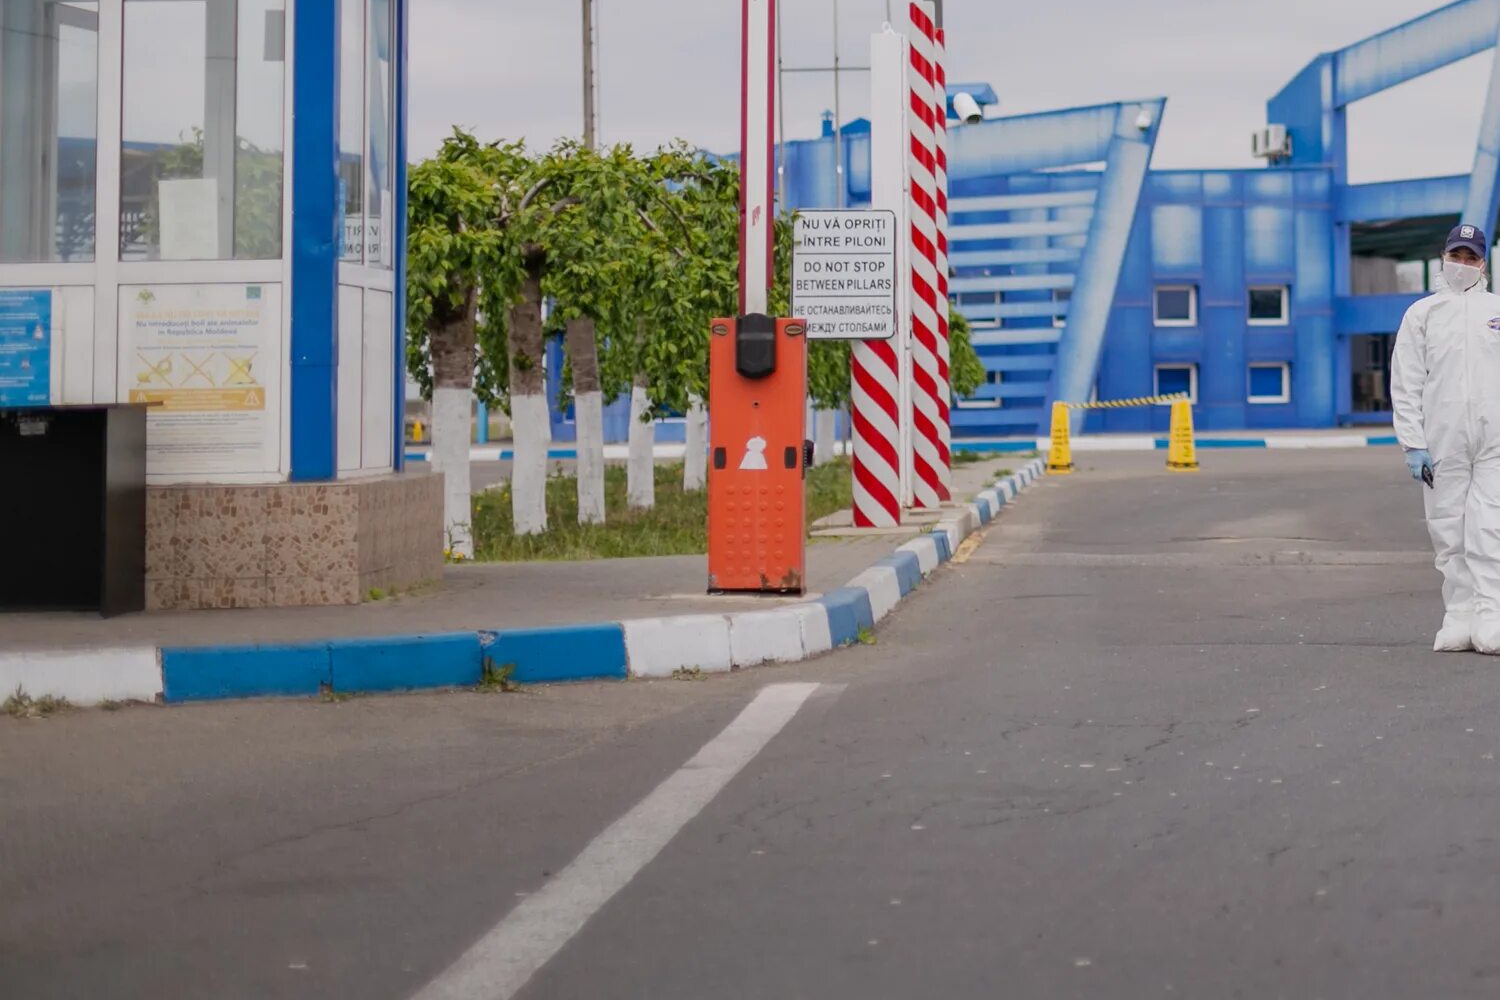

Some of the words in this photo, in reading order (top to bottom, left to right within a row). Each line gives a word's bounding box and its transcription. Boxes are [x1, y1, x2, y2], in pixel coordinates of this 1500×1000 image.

[802, 219, 820, 229] NU
[824, 217, 840, 229] VĂ
[803, 235, 841, 247] ÎNTRE
[845, 236, 886, 247] PILONI
[804, 262, 821, 273] DO
[825, 262, 849, 272] NOT
[854, 262, 885, 273] STOP
[796, 279, 844, 290] BETWEEN
[847, 279, 891, 290] PILLARS
[794, 306, 805, 315] НЕ
[807, 303, 892, 315] ОСТАНАВЛИВАЙТЕСЬ
[838, 323, 887, 333] СТОЛБАМИ
